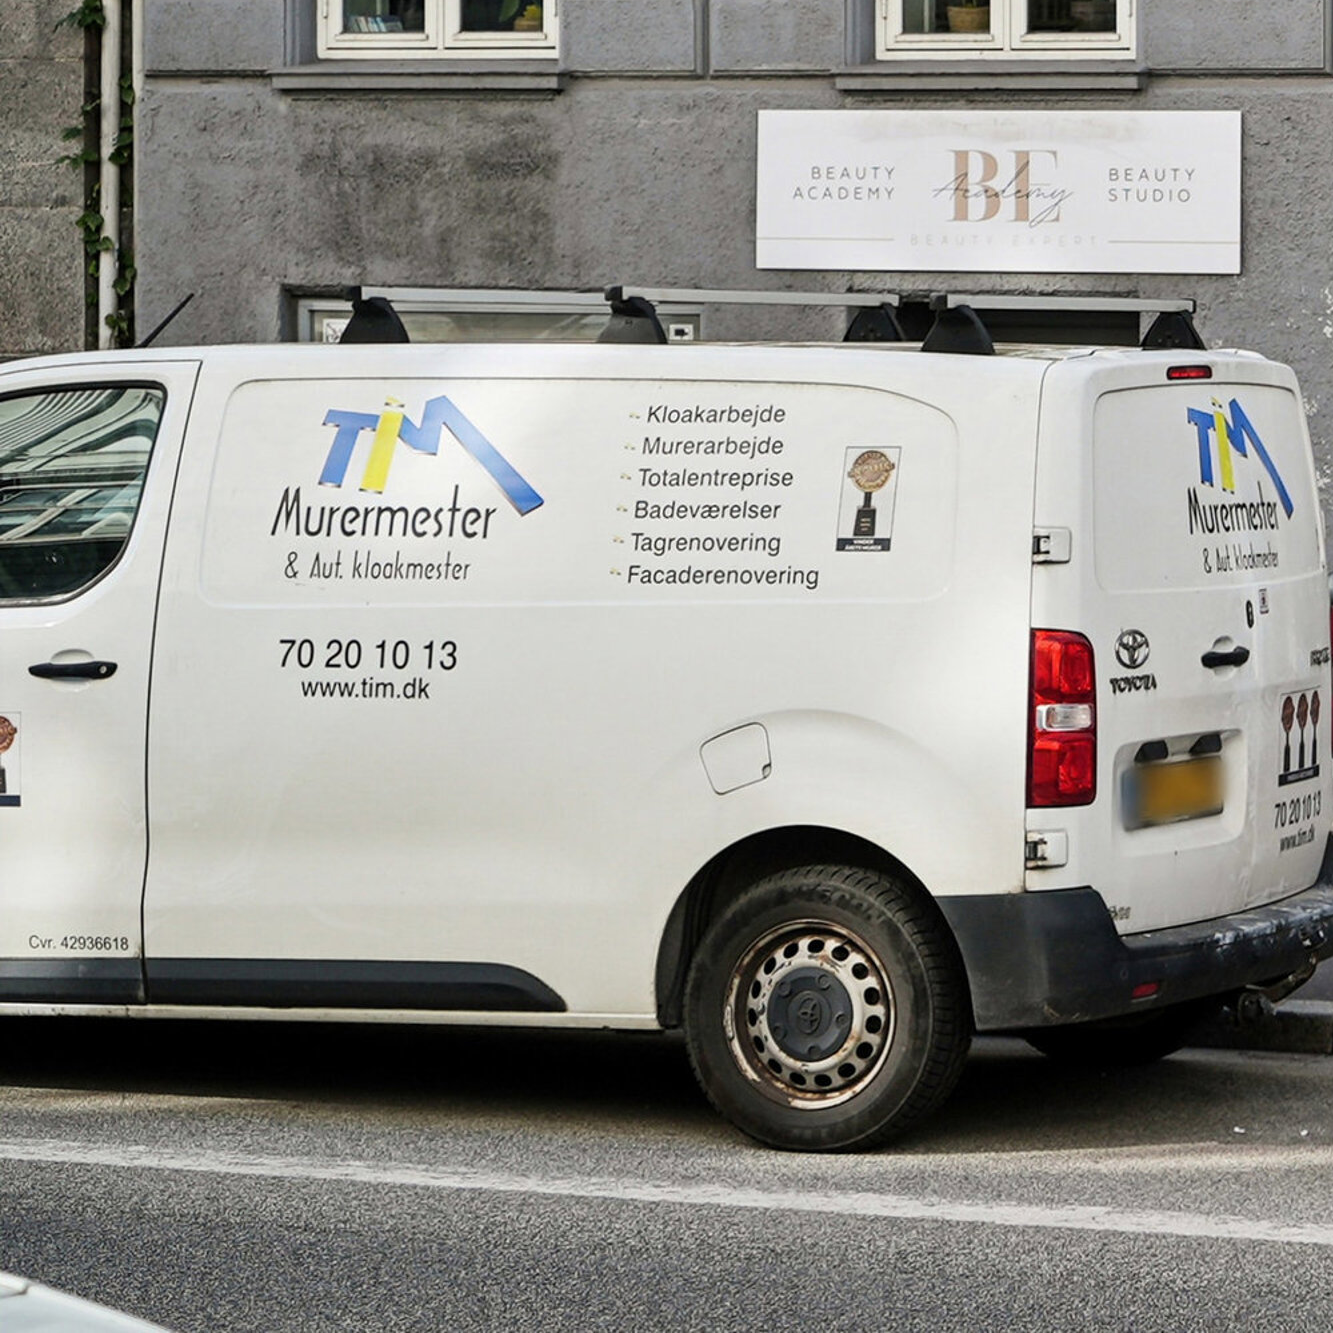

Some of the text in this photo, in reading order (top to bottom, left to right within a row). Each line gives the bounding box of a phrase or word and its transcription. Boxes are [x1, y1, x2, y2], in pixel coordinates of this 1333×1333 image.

[811, 166, 896, 181] BEAUTY
[1108, 168, 1196, 183] BEAUTY
[793, 185, 895, 201] ACADEMY
[945, 149, 1061, 223] BE
[1108, 188, 1191, 203] STUDIO
[909, 234, 1098, 247] BEAUTY EXPERT
[647, 405, 786, 428] Kloakarbejde
[642, 437, 784, 460] Murerarbejde
[638, 468, 794, 491] Totalentreprise
[270, 484, 497, 538] Murermester
[634, 500, 781, 519] Badeværelser
[1187, 481, 1279, 535] Murermester
[630, 532, 781, 557] Tagrenovering
[284, 550, 470, 580] & Aut. kloakmester
[1203, 548, 1212, 573] &
[627, 565, 819, 589] Facaderenovering
[279, 639, 458, 671] 70 20 10 13
[301, 677, 430, 700] www.tim.dk
[1110, 673, 1157, 695] TOYOTA
[1274, 790, 1322, 829] 70 20 10 13
[28, 934, 129, 952] Cvr. 42936618
